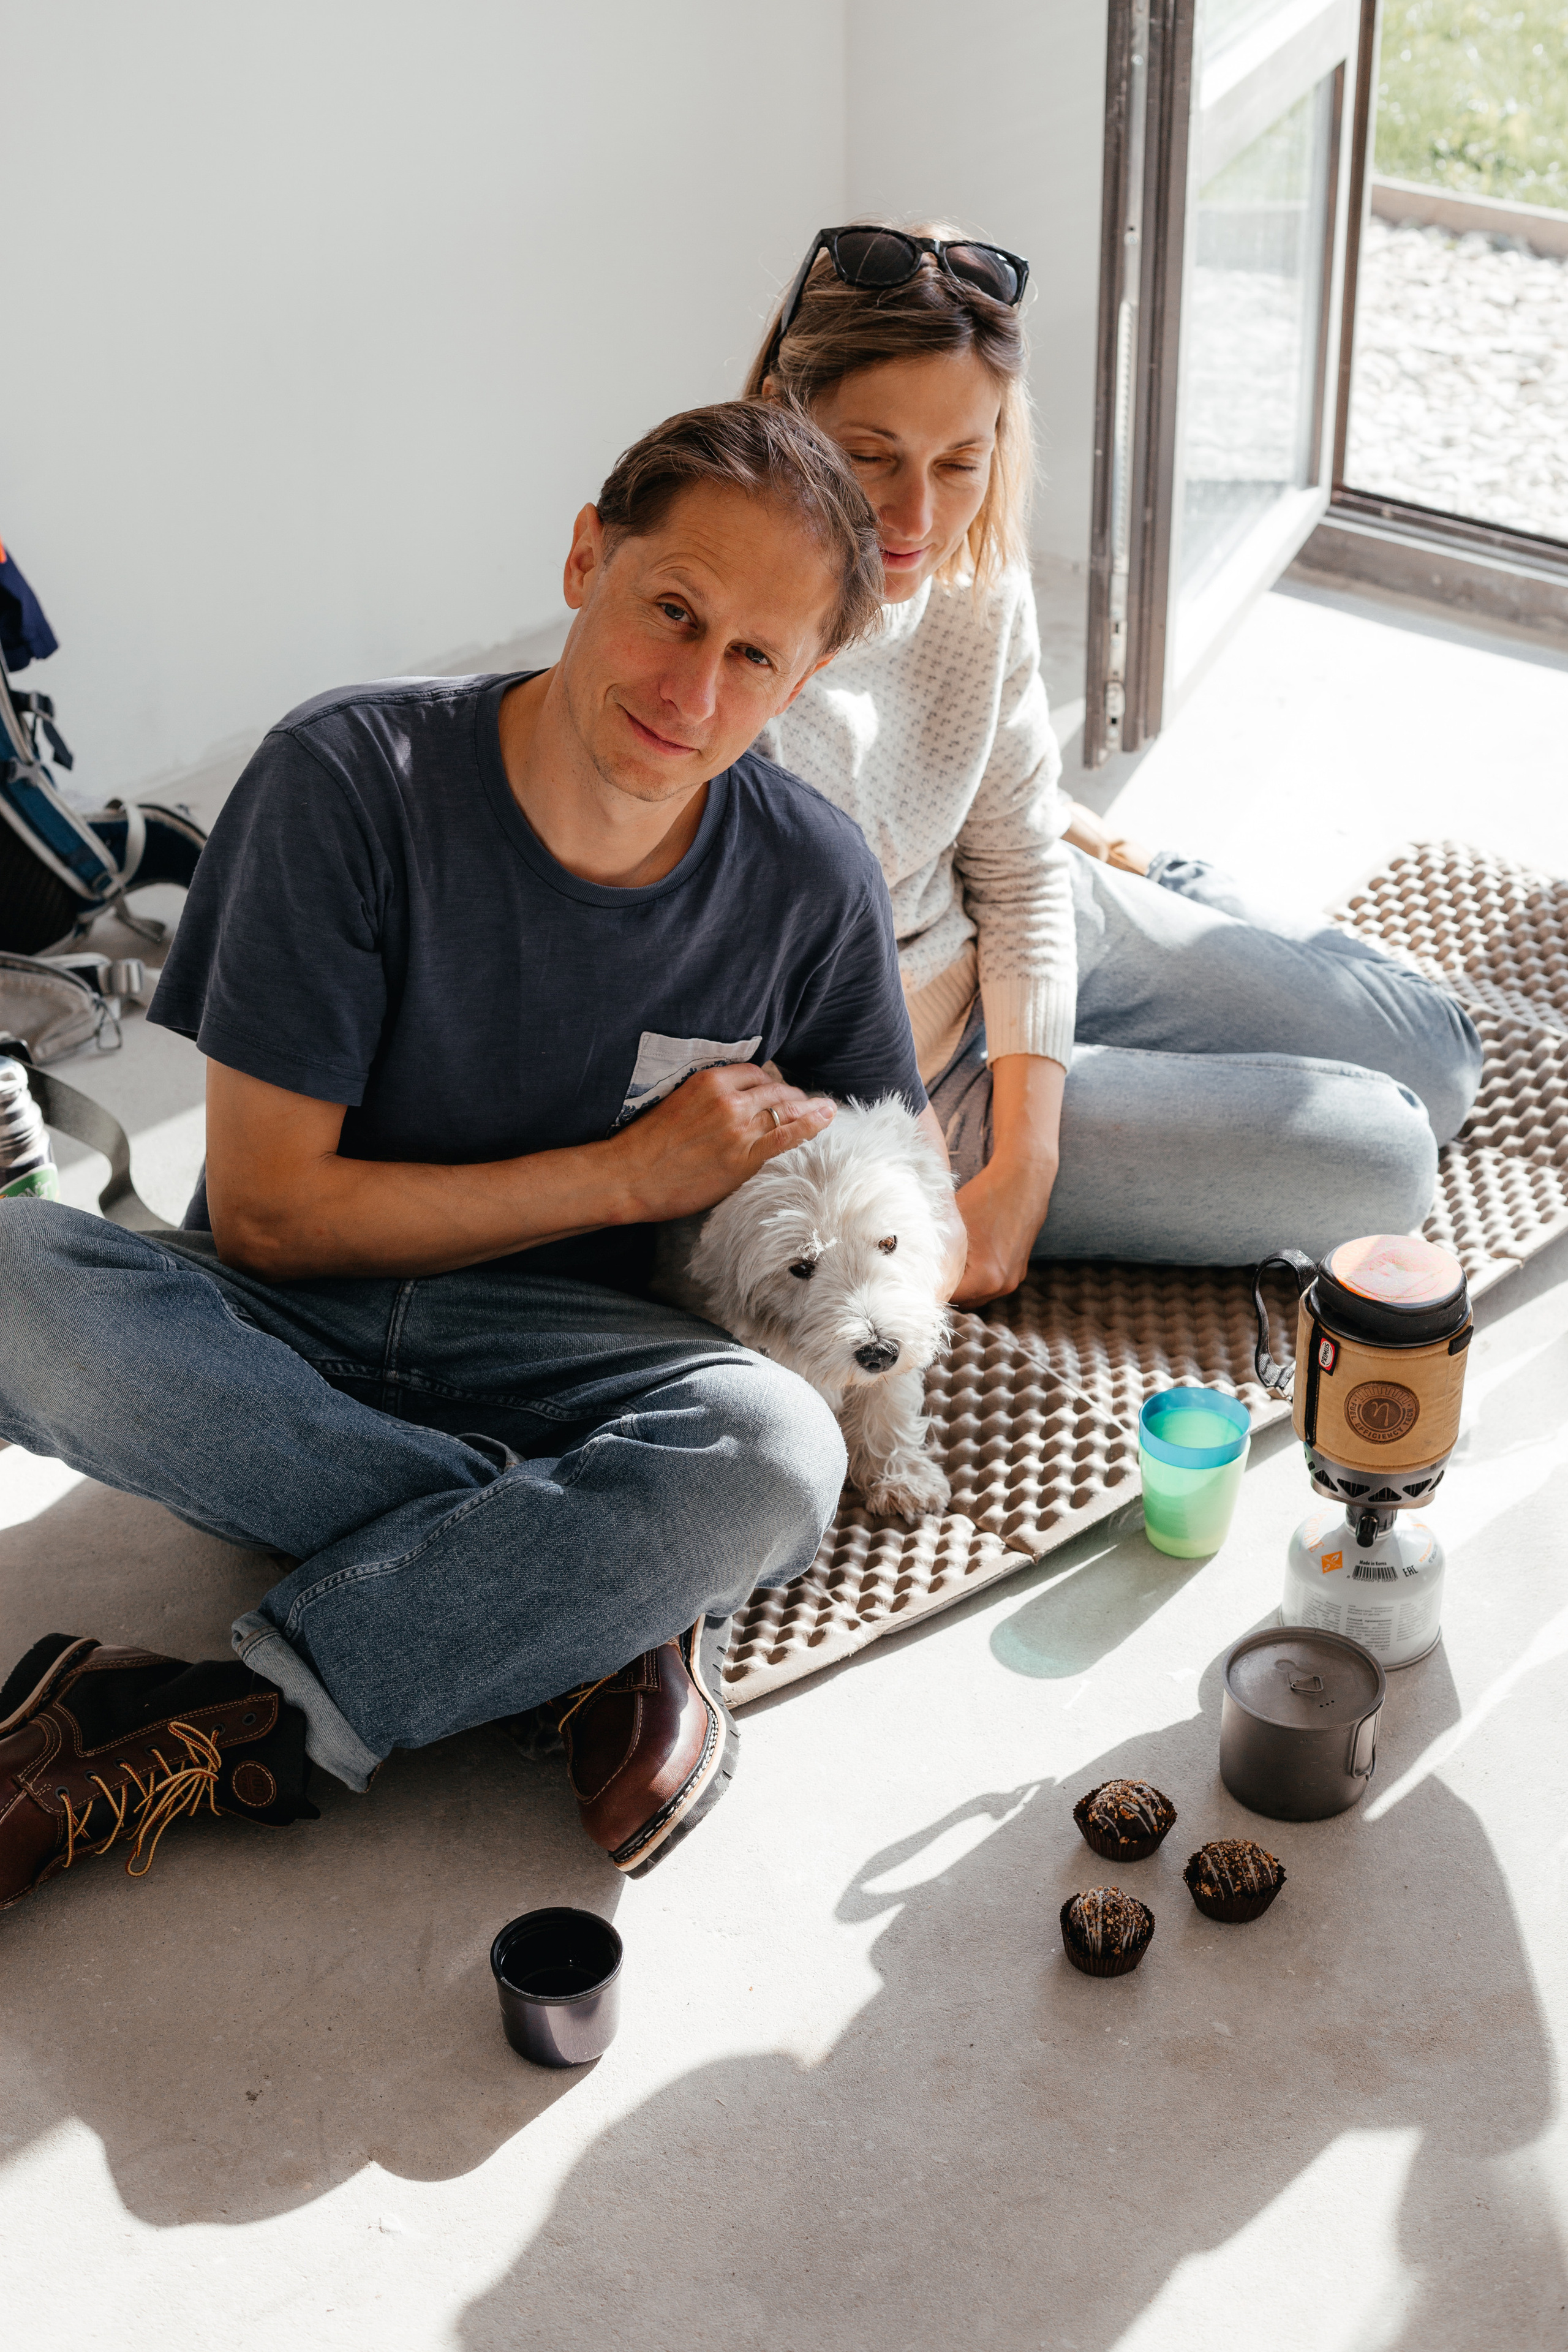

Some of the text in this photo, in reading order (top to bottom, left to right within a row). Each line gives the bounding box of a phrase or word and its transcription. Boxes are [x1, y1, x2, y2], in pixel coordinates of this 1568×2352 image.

[1321, 1342, 1330, 1365] PRIMUS
[1355, 1422, 1403, 1439] EFFICIENCY
[1403, 1408, 1414, 1425] TECH
